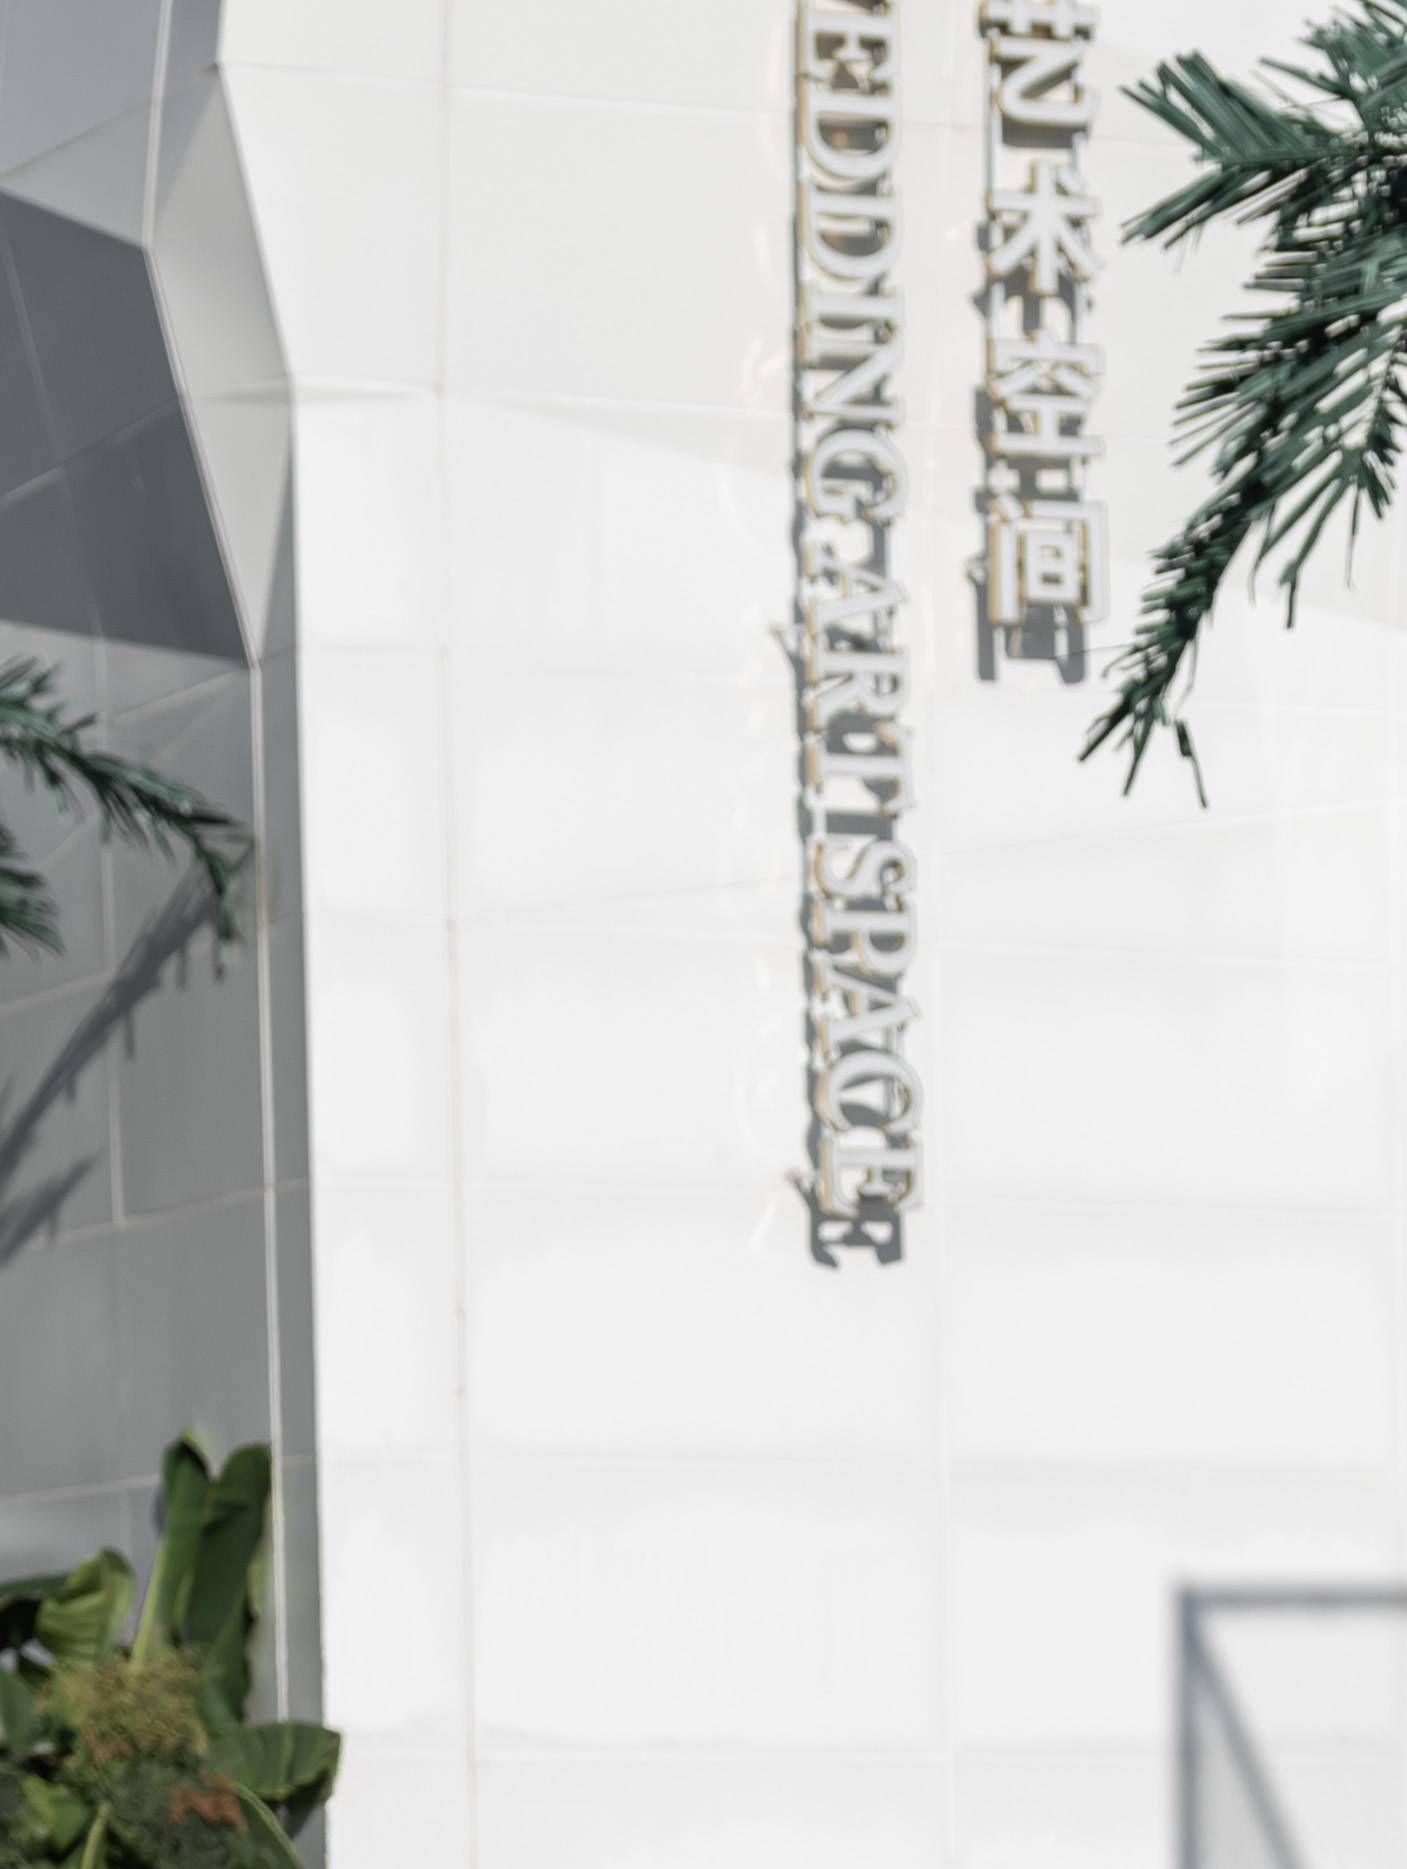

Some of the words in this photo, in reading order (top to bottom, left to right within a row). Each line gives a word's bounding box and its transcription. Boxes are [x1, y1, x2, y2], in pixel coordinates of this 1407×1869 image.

[800, 0, 908, 528] EDDING
[806, 538, 917, 815] ART
[813, 837, 925, 1211] SPACE
